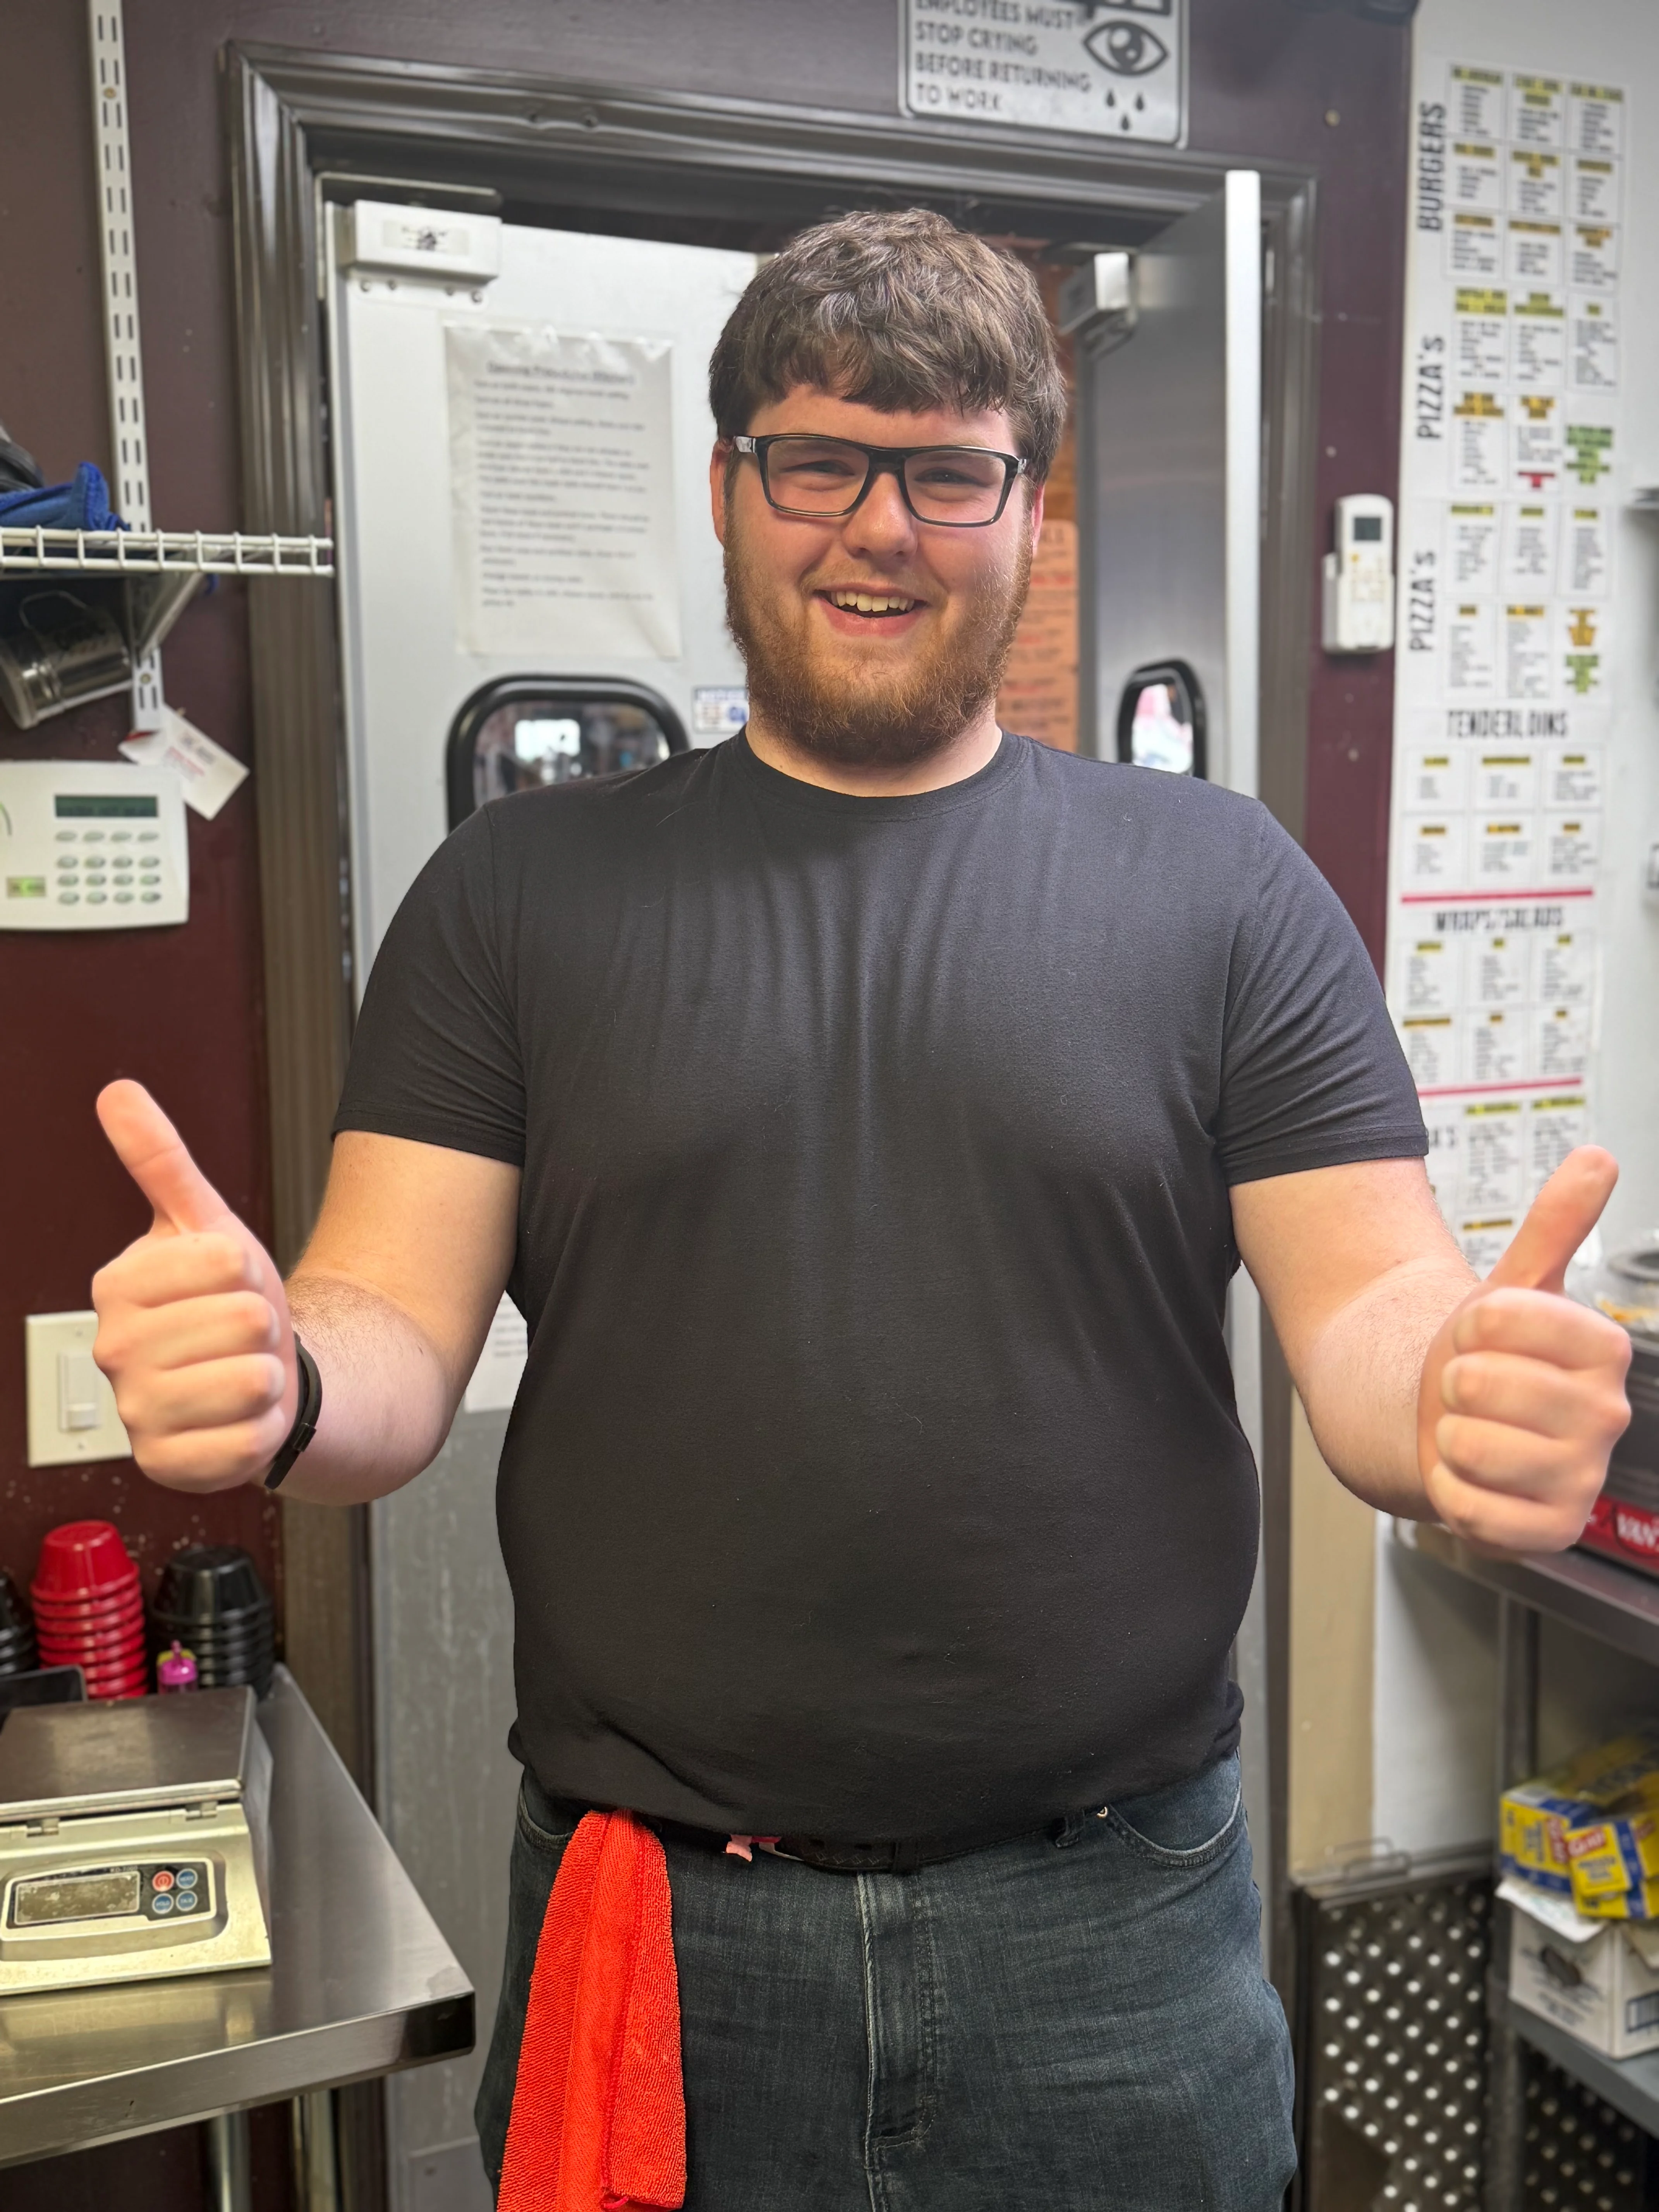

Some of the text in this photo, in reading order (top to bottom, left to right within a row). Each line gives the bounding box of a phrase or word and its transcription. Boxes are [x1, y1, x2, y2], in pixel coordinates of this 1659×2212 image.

[1025, 6, 1073, 29] MUST
[916, 20, 1039, 56] STOP CRYING
[916, 52, 1091, 93] BEFORE RETURNING
[916, 82, 1002, 111] TO WORK
[1419, 102, 1446, 231] BURGERS
[1417, 335, 1444, 438] PIZZA'S
[1409, 550, 1435, 651] PIZZA'S
[1448, 708, 1567, 739] TENDERLOINS
